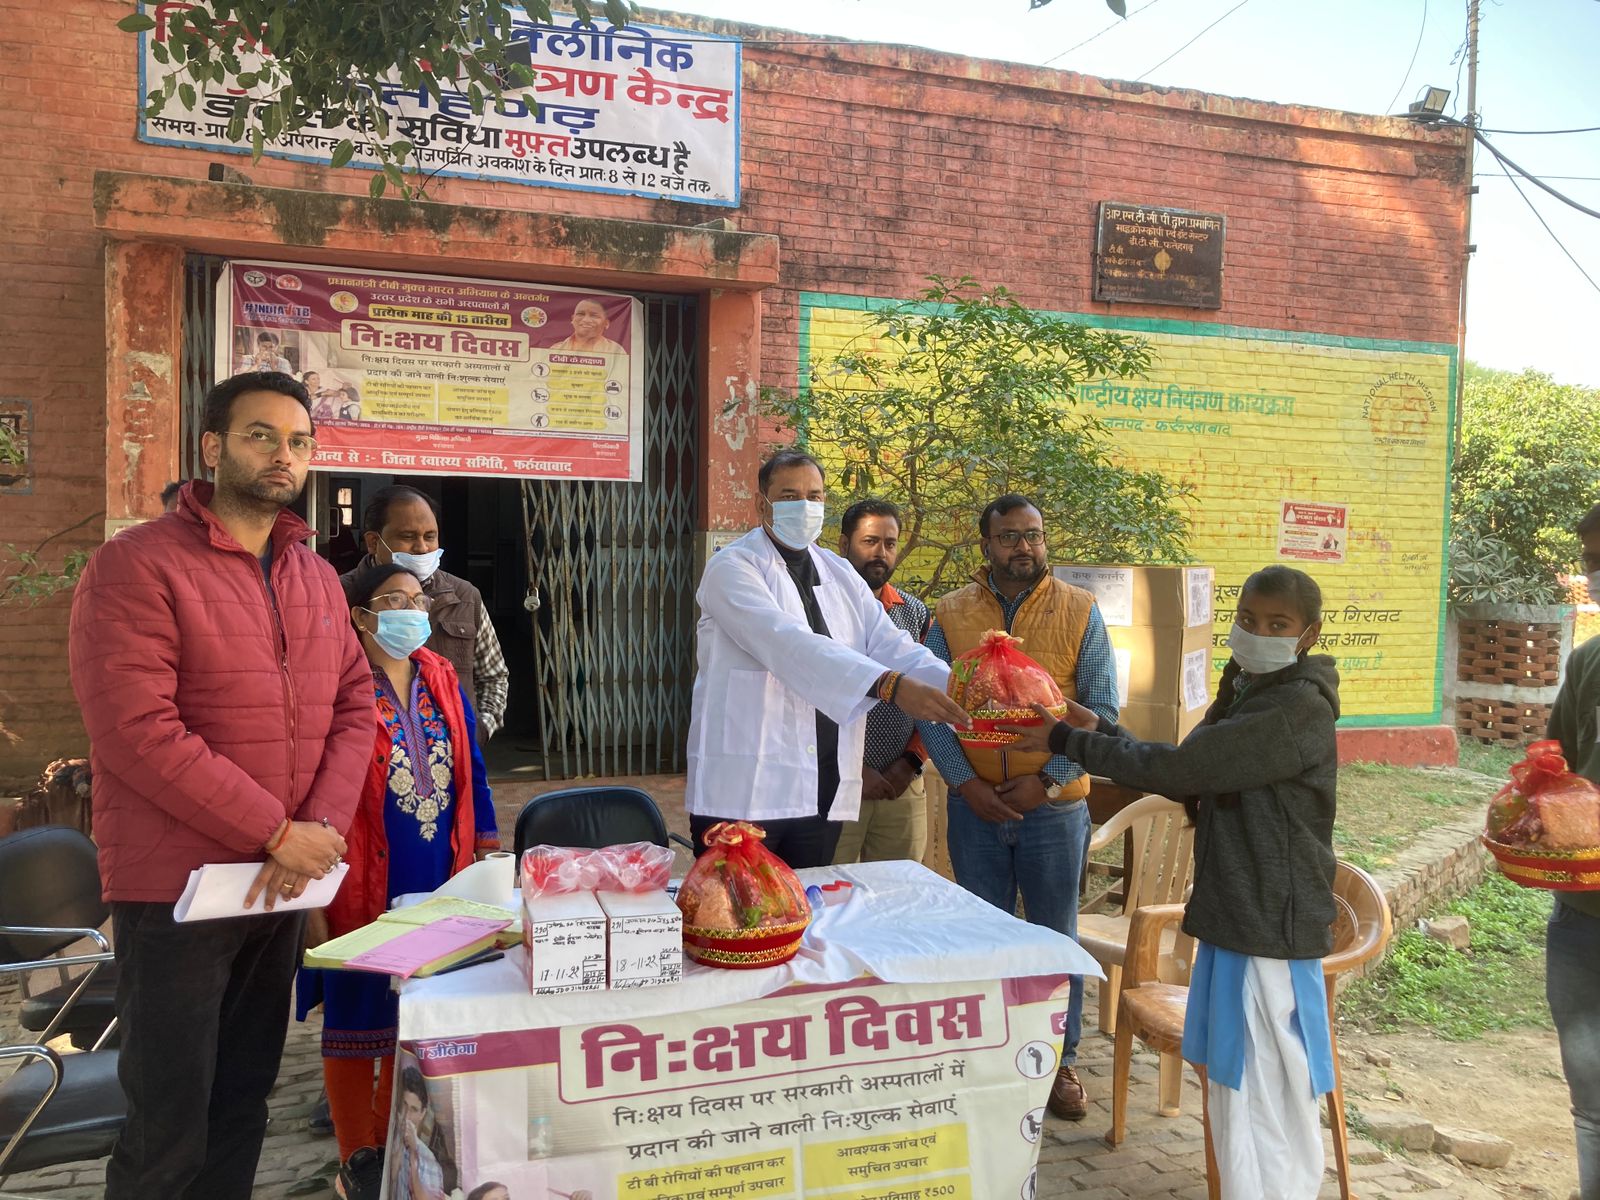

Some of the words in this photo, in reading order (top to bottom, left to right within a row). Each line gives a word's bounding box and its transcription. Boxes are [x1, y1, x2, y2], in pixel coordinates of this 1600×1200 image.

[626, 66, 733, 124] केन्द्र
[570, 137, 670, 168] उपलब्ध
[672, 140, 692, 175] है
[608, 168, 618, 184] 8
[621, 165, 637, 186] से
[640, 171, 656, 189] 12
[686, 178, 711, 194] तक
[436, 310, 452, 322] की
[456, 314, 468, 324] 15
[450, 330, 523, 358] दिवस
[1340, 633, 1380, 647] आना
[824, 993, 986, 1057] दिवस
[427, 1041, 478, 1060] जीतेगा
[689, 1095, 745, 1117] दिवस
[750, 1090, 776, 1107] पर
[781, 1074, 855, 1103] सरकारी
[860, 1062, 945, 1092] अस्पतालों
[949, 1059, 966, 1079] में
[626, 1137, 680, 1161] प्रदान
[685, 1129, 715, 1151] की
[721, 1121, 763, 1144] जाने
[768, 1113, 816, 1137] वाली
[836, 1142, 891, 1159] आवश्यक
[919, 1131, 938, 1148] एवं
[626, 1175, 641, 1191] टी
[661, 1166, 704, 1186] रोगियों
[704, 1164, 723, 1178] की
[723, 1159, 764, 1176] पहचान
[765, 1155, 786, 1168] कर
[847, 1160, 891, 1178] समुचित
[892, 1156, 929, 1170] उपचार
[747, 1176, 786, 1192] उपचार
